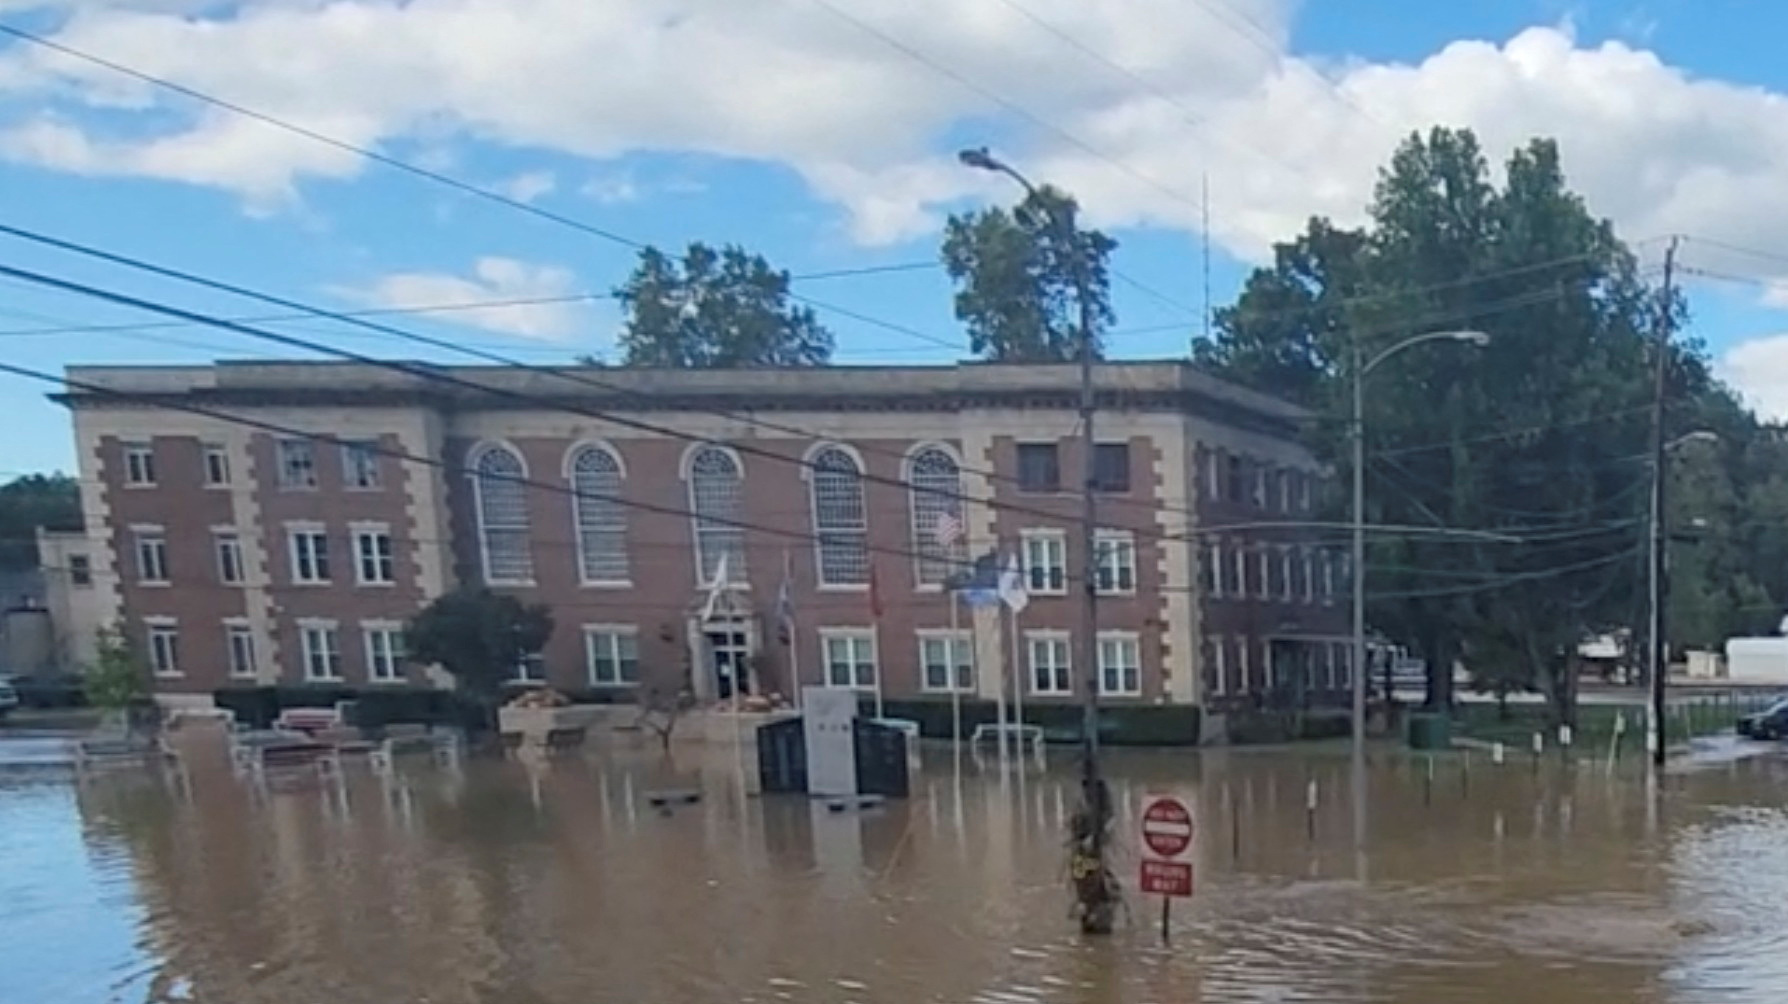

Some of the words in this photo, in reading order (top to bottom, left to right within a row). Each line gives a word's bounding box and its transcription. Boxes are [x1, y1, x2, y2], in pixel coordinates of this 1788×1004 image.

[1166, 810, 1187, 820] NOT
[1151, 836, 1183, 847] ENTER
[1145, 865, 1187, 879] WRONG
[1152, 879, 1179, 890] WAY
